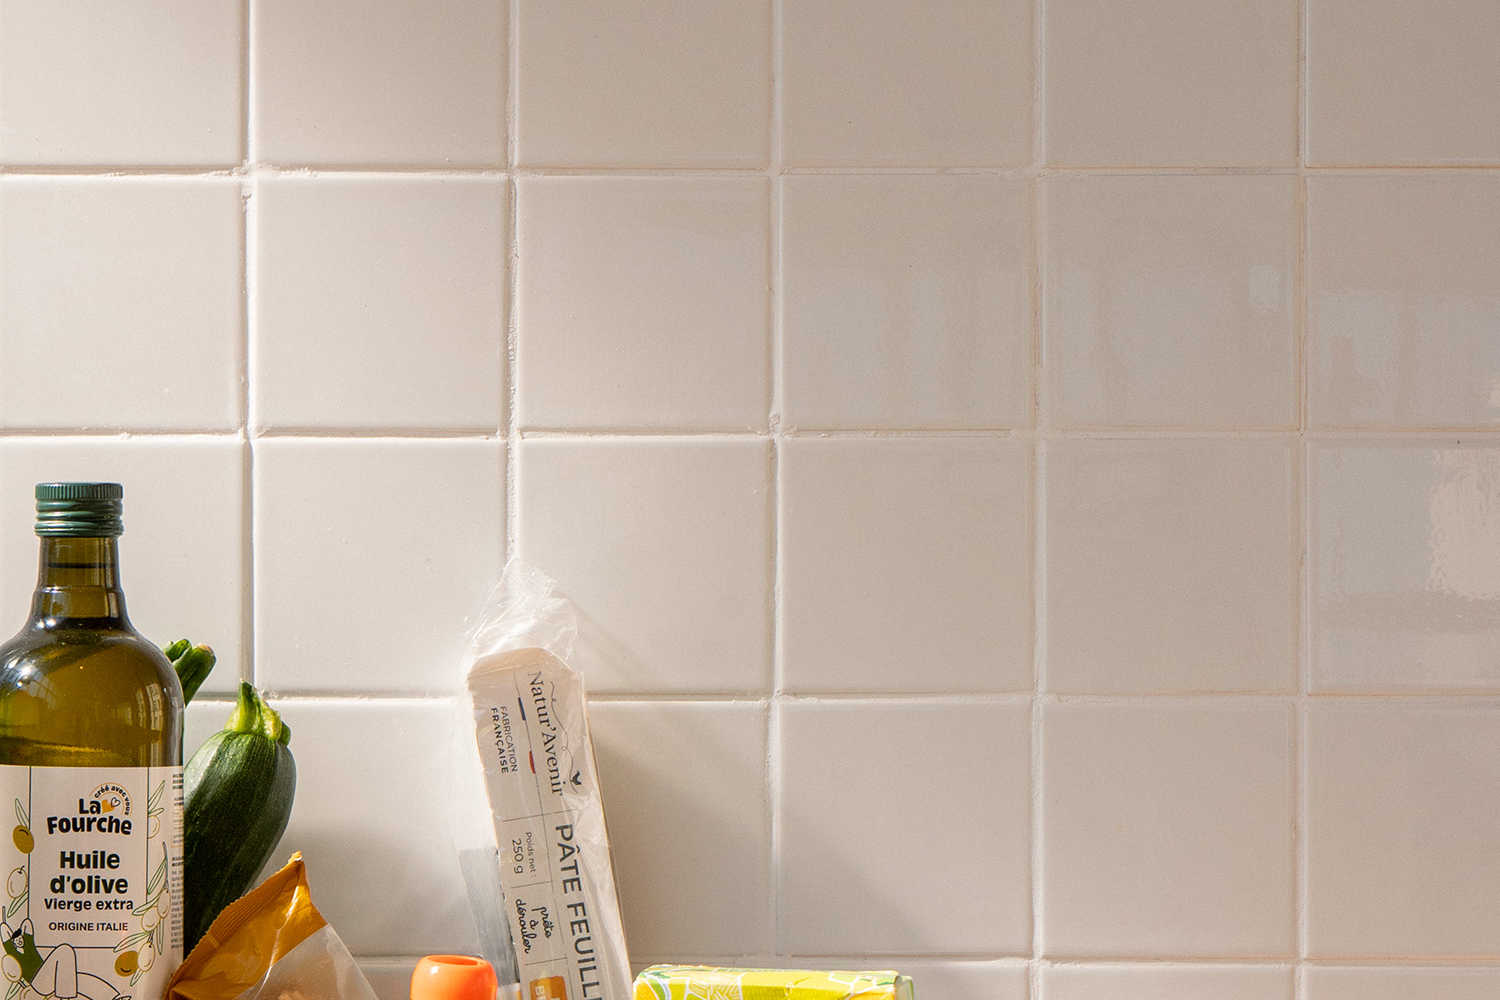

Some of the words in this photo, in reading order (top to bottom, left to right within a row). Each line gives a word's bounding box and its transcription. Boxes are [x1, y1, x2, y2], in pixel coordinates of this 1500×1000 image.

[490, 706, 510, 775] FRANÇAISE
[499, 705, 519, 773] FABRICATION
[527, 670, 567, 797] Natur'Avenir
[110, 785, 127, 798] avec
[78, 798, 101, 815] La
[47, 815, 132, 836] Fourche
[511, 838, 524, 863] 250
[525, 831, 535, 856] Poids
[59, 850, 121, 870] Huile
[513, 864, 524, 875] g
[555, 823, 582, 895] PÂTE
[49, 874, 129, 895] d'olive
[44, 898, 92, 912] Vierge
[95, 898, 134, 911] extra
[48, 922, 94, 932] ORIGINE
[96, 922, 129, 931] ITALIE
[514, 898, 532, 954] dérouler
